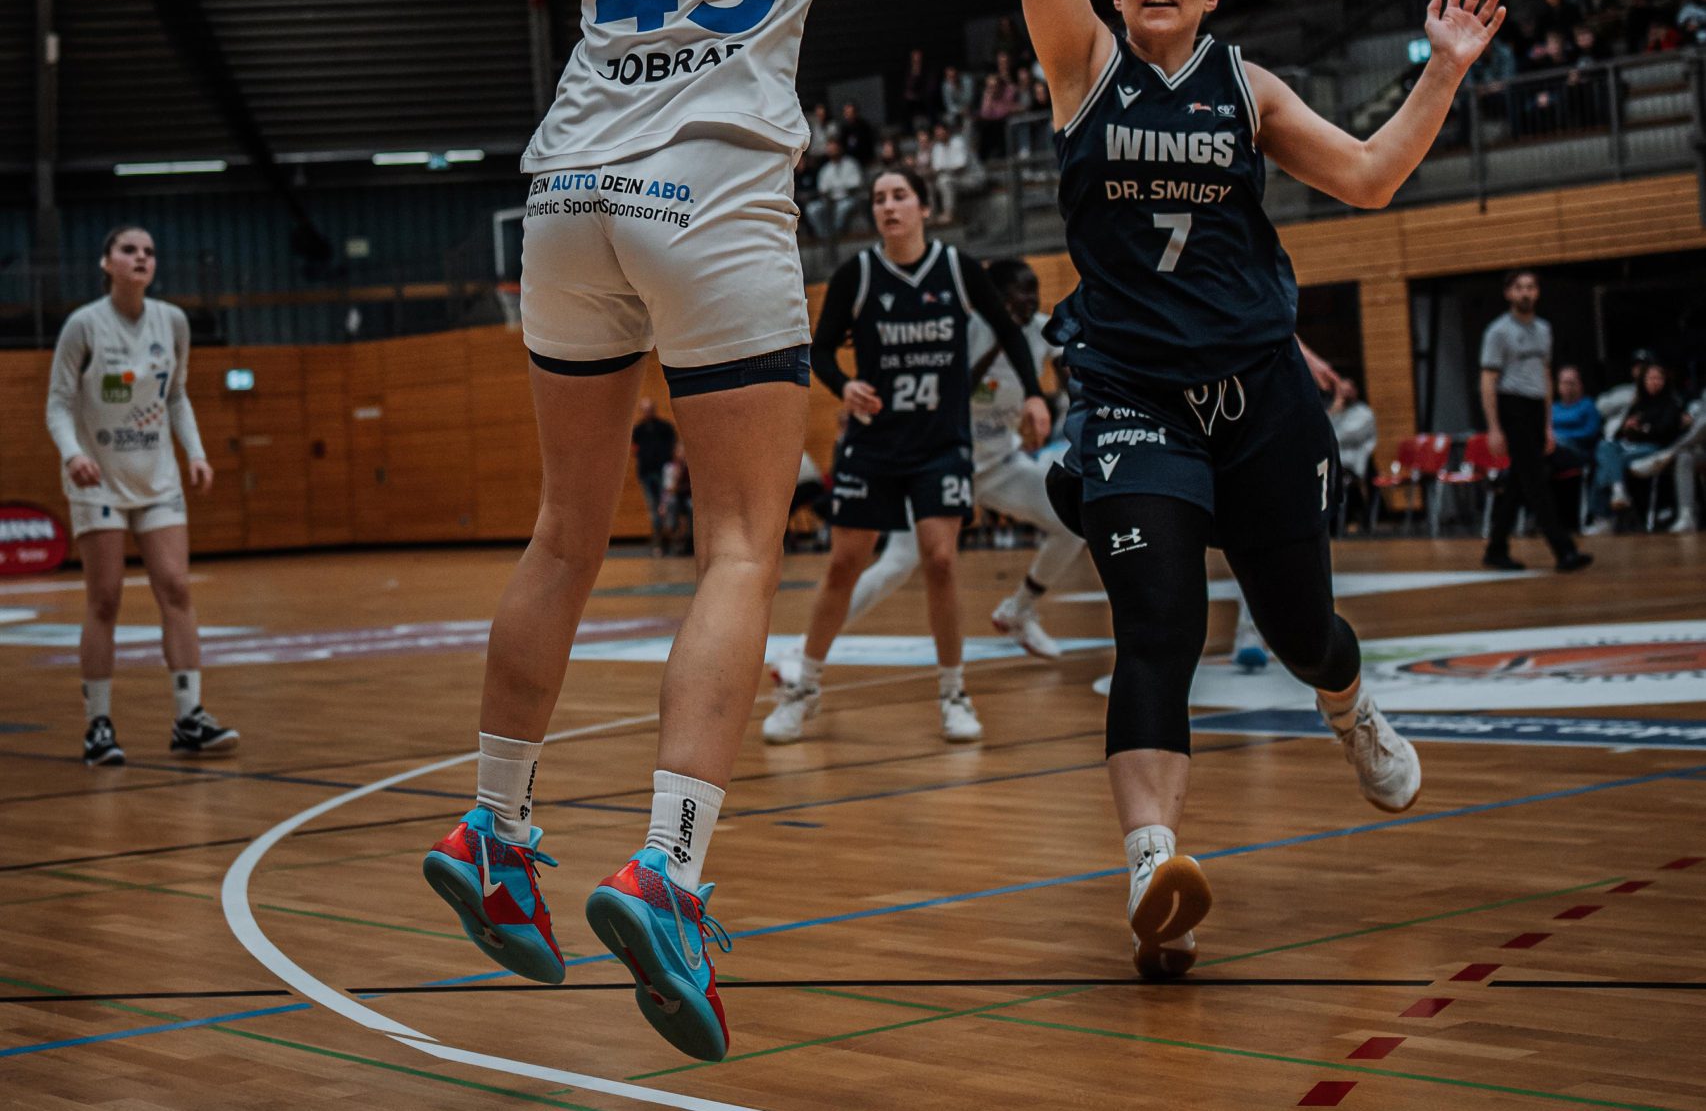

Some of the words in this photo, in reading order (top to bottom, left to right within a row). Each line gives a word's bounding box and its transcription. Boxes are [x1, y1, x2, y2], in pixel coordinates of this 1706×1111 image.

[1106, 123, 1235, 168] WINGS
[601, 174, 645, 195] DEIN
[645, 180, 695, 204] ABO.
[1105, 180, 1144, 201] DR.
[1150, 180, 1232, 204] SMUSY
[600, 198, 691, 229] Sponsoring
[1153, 213, 1192, 272] 7
[876, 315, 955, 346] WINGS
[156, 372, 168, 399] 7
[892, 372, 941, 412] 24
[1097, 426, 1167, 448] wupsi
[942, 475, 973, 508] 24
[679, 798, 697, 850] CRAFT
